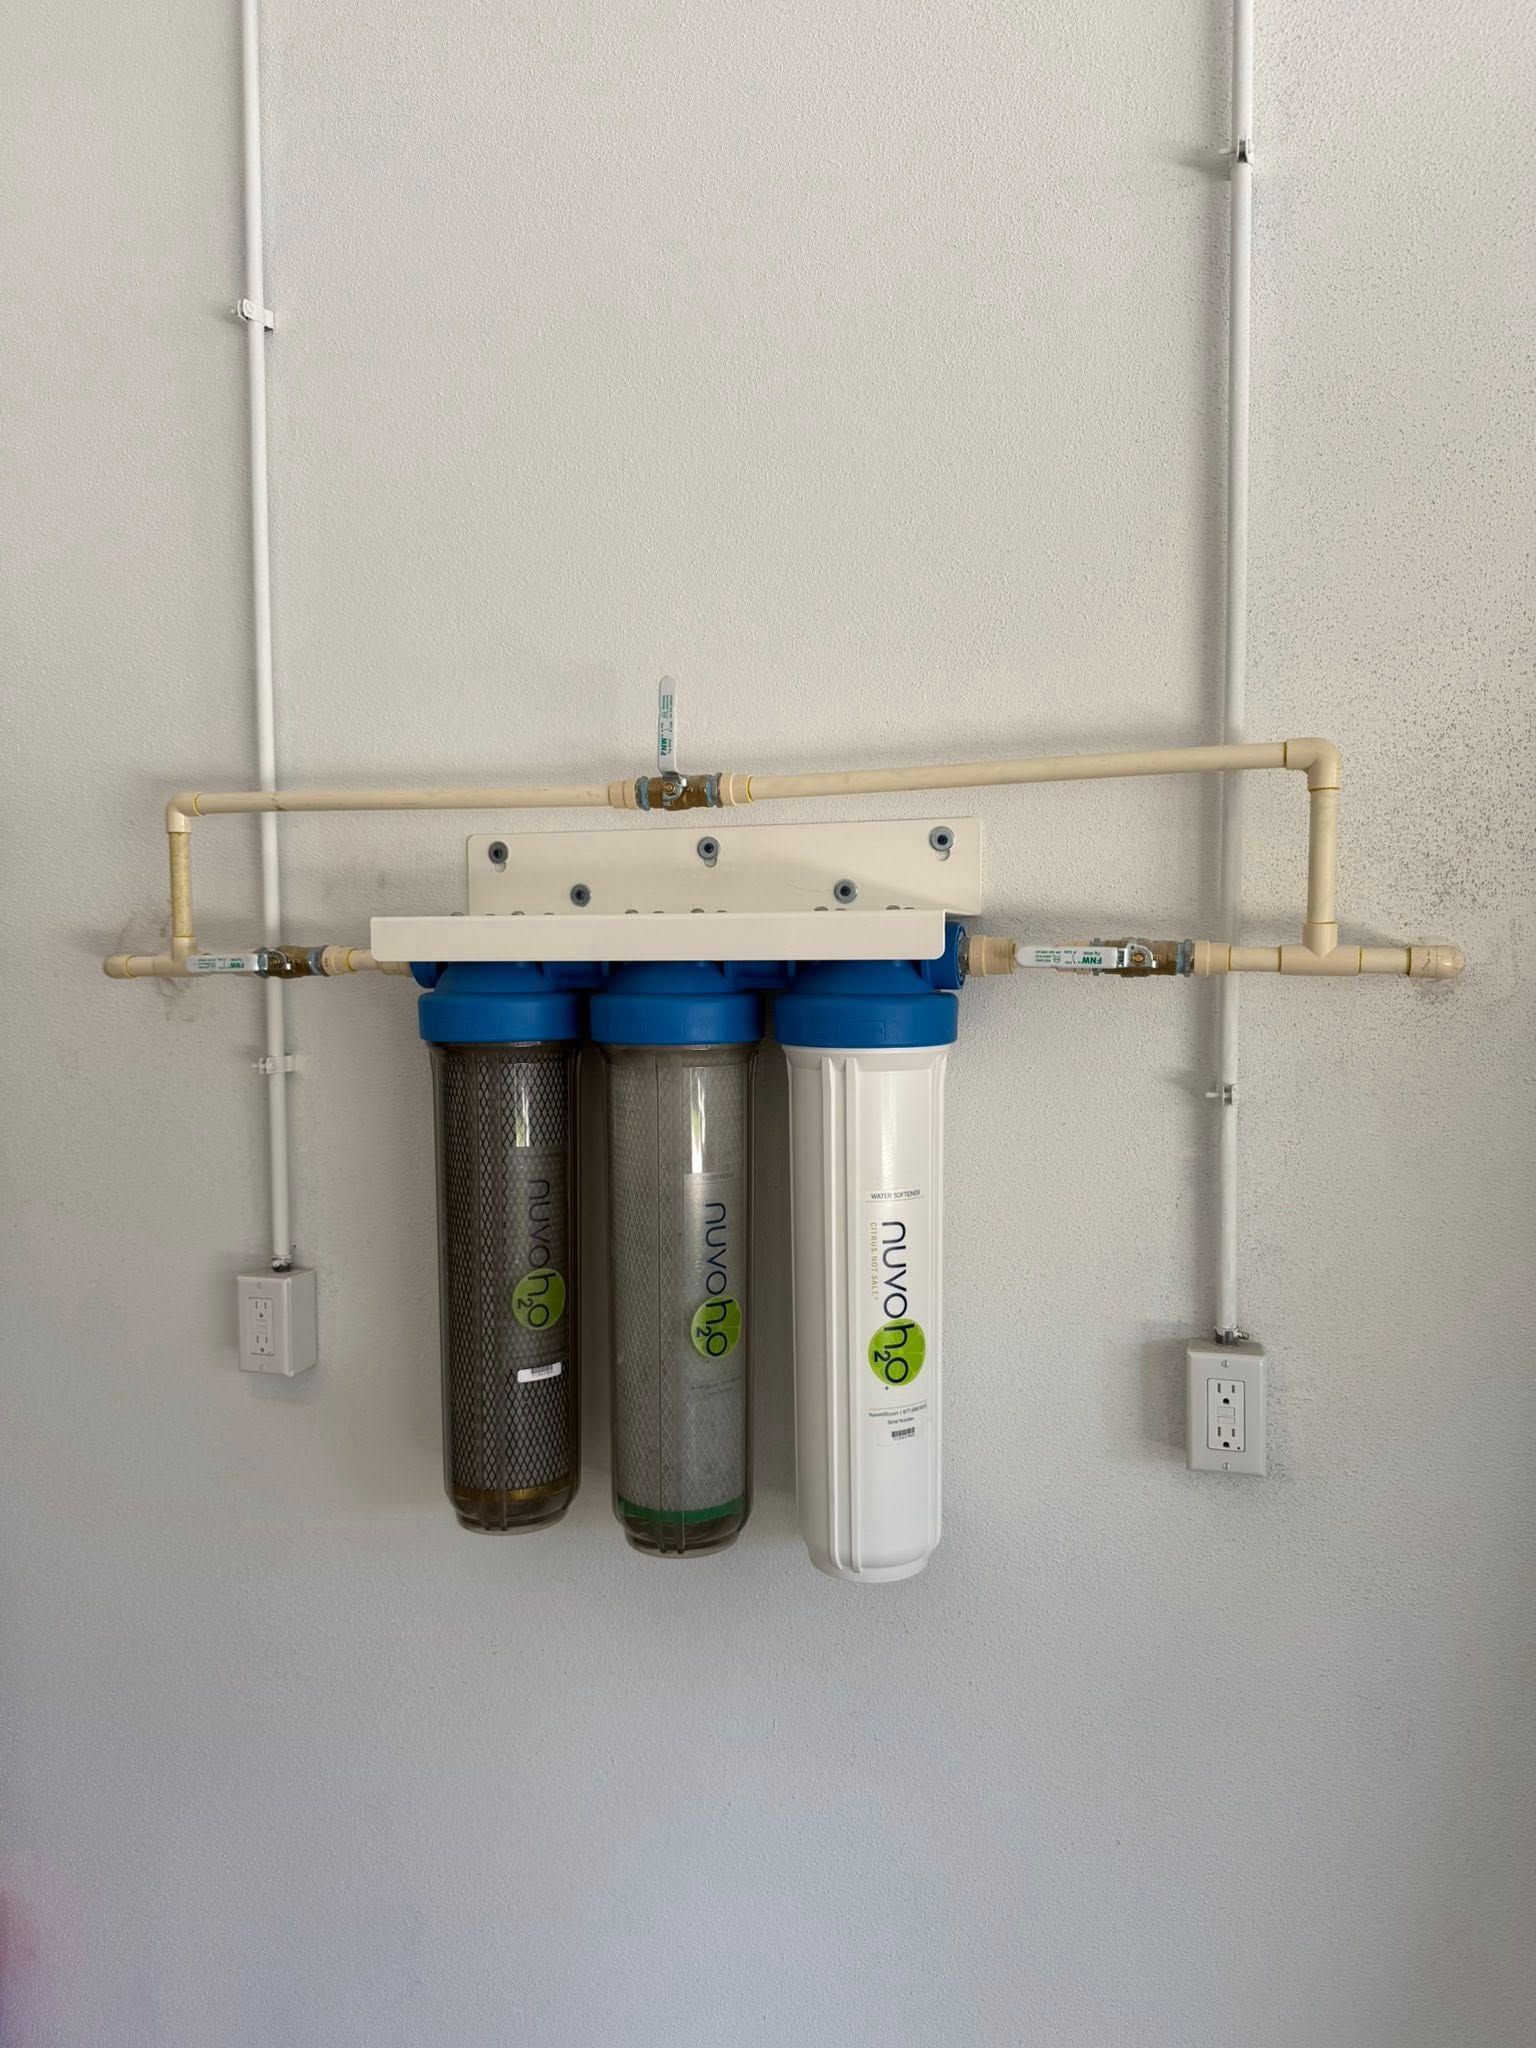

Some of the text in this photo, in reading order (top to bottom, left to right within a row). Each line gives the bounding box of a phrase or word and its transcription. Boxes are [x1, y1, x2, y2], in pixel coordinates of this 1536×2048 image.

[1081, 957, 1102, 965] FNW
[871, 1189, 921, 1200] WATER SOFTENER
